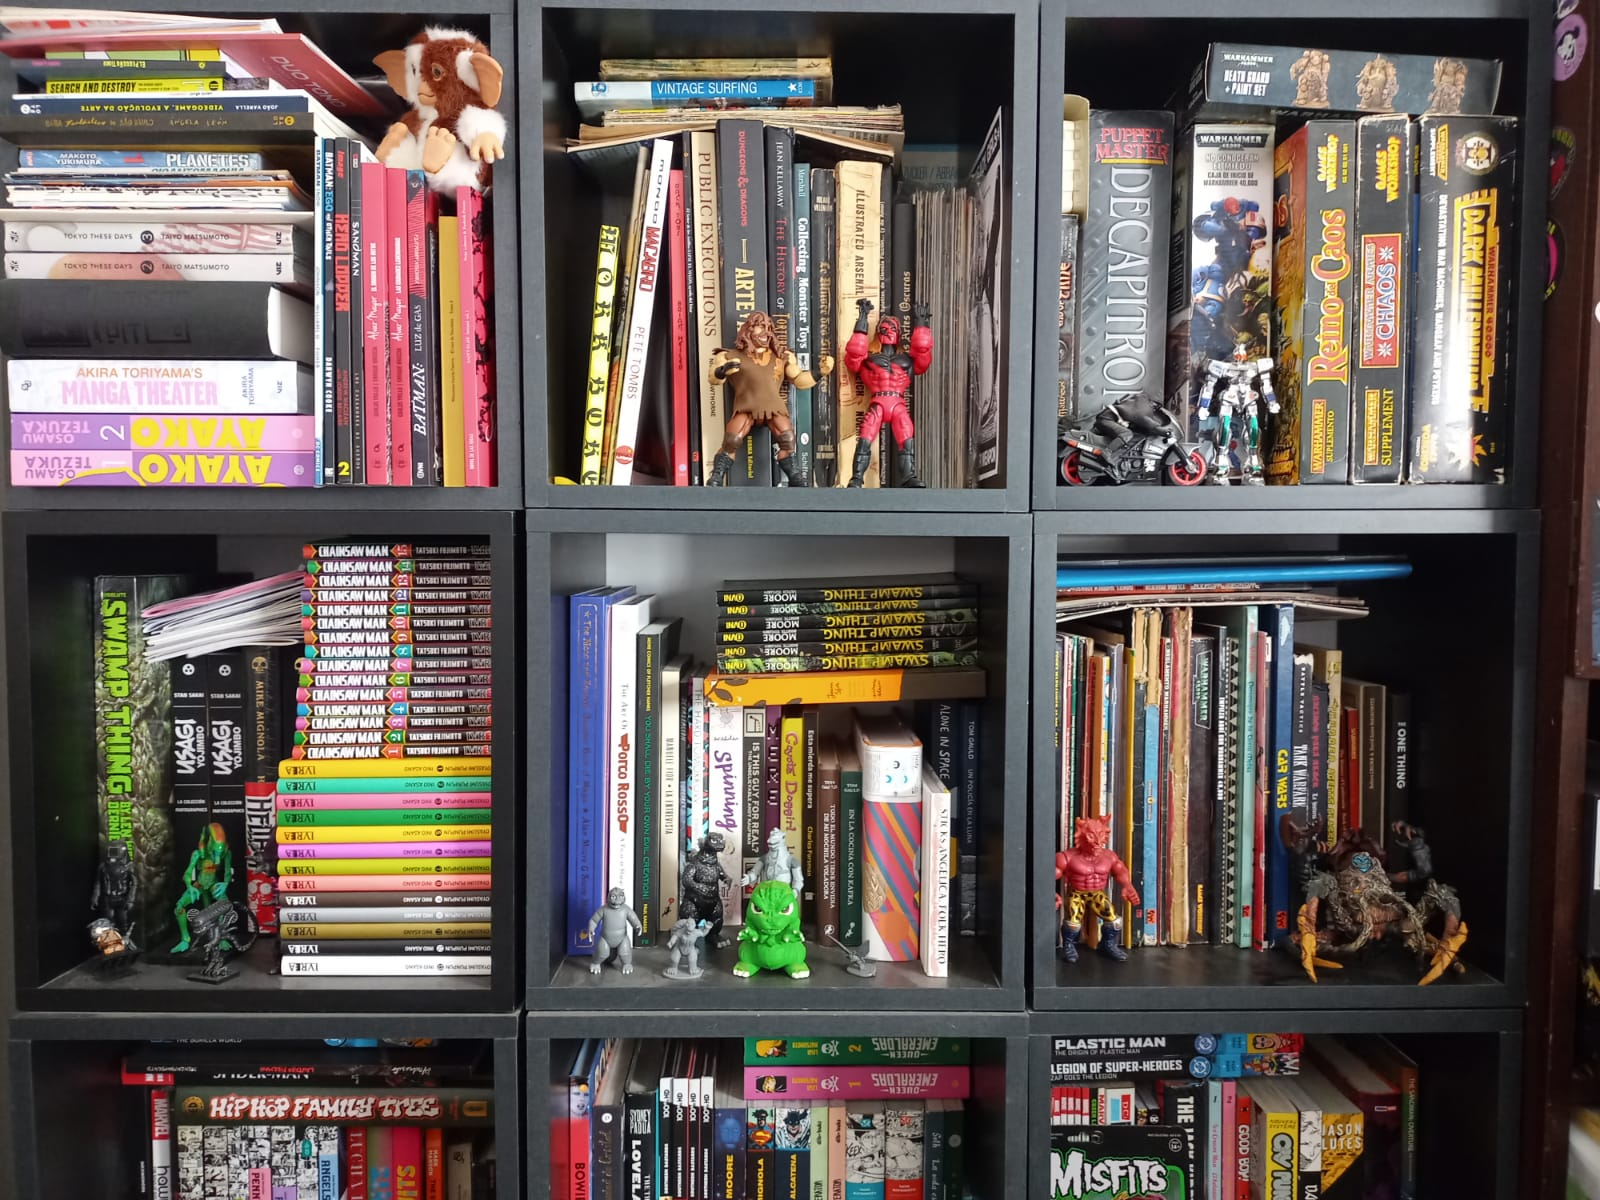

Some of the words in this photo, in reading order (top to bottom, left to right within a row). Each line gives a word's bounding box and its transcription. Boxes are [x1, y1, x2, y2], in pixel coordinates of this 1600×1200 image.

[50, 83, 80, 94] SEARCH
[83, 82, 99, 93] AND
[101, 81, 137, 92] DESTROY
[271, 55, 309, 81] DUO
[305, 82, 347, 108] TONO
[656, 83, 706, 95] VINTAGE
[708, 83, 758, 95] SURFING
[1223, 69, 1247, 83] DEATH
[1247, 71, 1271, 84] GUARD
[1231, 82, 1252, 95] PAINT
[1253, 84, 1266, 97] SET
[80, 104, 101, 112] ARTE
[103, 104, 115, 112] DA
[117, 103, 161, 113] EVOLUÇÃO
[262, 104, 278, 112] JOÃO
[1101, 128, 1167, 143] PUPPET
[1200, 135, 1262, 144] WARHAMMER
[165, 153, 250, 168] PLANETES
[738, 130, 747, 175] DUNGEONS
[776, 142, 784, 162] JEAN
[1095, 143, 1170, 165] MASTER
[1317, 146, 1328, 181] GAMES
[1326, 134, 1339, 193] WORKSHOP
[325, 152, 334, 190] BATMAN:
[737, 176, 749, 188] &
[798, 168, 806, 197] Marshall
[698, 152, 713, 217] PUBLIC
[776, 165, 785, 208] KELLAWAY
[325, 191, 334, 212] EGO
[739, 188, 748, 227] DRAGONS
[335, 214, 349, 252] HEAD
[776, 217, 788, 241] THE
[855, 190, 866, 251] ILLUSTRATED
[1436, 194, 1448, 248] DEVASTATING
[184, 233, 230, 241] MATSUMOTO
[795, 217, 809, 273] Collecting
[1311, 209, 1351, 281] Caos
[1461, 207, 1486, 263] DARK
[352, 222, 362, 276] SANDMAN
[639, 226, 661, 293] MACABRO
[1436, 248, 1446, 267] WAR
[335, 255, 349, 311] LOPPER
[700, 223, 717, 337] EXECUTIONS
[776, 246, 789, 294] HISTORY
[855, 255, 866, 295] ARSENAL
[735, 267, 755, 311] ARTE
[798, 277, 809, 323] Monster
[1325, 282, 1337, 297] del
[1376, 263, 1396, 340] CHAOS
[1433, 268, 1446, 310] MACHINES,
[413, 304, 422, 322] GAS
[776, 296, 784, 309] OF
[414, 323, 422, 332] de
[632, 326, 646, 353] PETE
[798, 326, 810, 349] Toys
[1433, 311, 1444, 350] WARGEAR
[414, 333, 422, 352] LUZ
[1307, 296, 1350, 386] Reino
[325, 357, 333, 388] DARWYN
[1433, 351, 1442, 368] AND
[76, 367, 118, 379] AKIRA
[122, 367, 203, 379] TORIYAMA'S
[626, 358, 641, 400] TOMBS
[62, 381, 131, 405] MANGA
[137, 381, 219, 405] THEATER
[412, 362, 427, 437] BATMAN:
[1431, 369, 1442, 405] PSYKERS
[325, 389, 333, 413] COOKE
[21, 421, 90, 433] TEZUKA
[22, 433, 75, 443] OSAMU
[99, 424, 125, 441] 2
[130, 418, 266, 449] AYAKO
[1312, 401, 1325, 472] WARHAMMER
[1326, 410, 1335, 462] SUPLEMENTO
[1381, 389, 1394, 466] SUPPLEMENT
[338, 461, 351, 476] 2
[319, 575, 366, 587] CHAINSAW
[367, 575, 389, 587] MAN
[398, 575, 408, 586] 13
[762, 632, 797, 641] MOORE
[822, 628, 866, 640] THING
[869, 626, 923, 637] SWAMP
[100, 599, 129, 698] SWAMP
[256, 680, 264, 707] MIKE
[1199, 657, 1209, 721] WARHAMMER
[939, 704, 951, 734] ALONE
[174, 718, 197, 775] USAGI
[196, 725, 206, 769] YOJIMBO
[256, 709, 265, 761] MIGNOLA
[752, 742, 760, 752] IS
[807, 729, 815, 746] Esta
[939, 736, 950, 747] IN
[1397, 728, 1407, 753] ONE
[104, 705, 133, 795] THING
[783, 731, 798, 777] Coyote
[807, 746, 815, 771] mierda
[1277, 748, 1288, 773] CAR
[1294, 744, 1308, 767] TANK
[752, 753, 760, 776] THIS
[807, 771, 813, 783] me
[939, 750, 951, 779] SPACE
[1396, 754, 1406, 789] THING
[714, 750, 739, 833] Spinning
[752, 777, 760, 798] GUY
[806, 783, 814, 809] supera
[1277, 776, 1288, 809] WARS
[1292, 769, 1307, 808] WARFARE
[752, 800, 760, 820] FOR
[784, 780, 798, 832] Doggirl
[847, 809, 855, 820] EN
[752, 821, 760, 853] REAL?
[847, 821, 855, 831] LA
[847, 832, 855, 861] COCINA
[847, 862, 855, 879] CON
[847, 880, 855, 906] KAFKA
[288, 945, 319, 953] IVREA
[1055, 1037, 1132, 1049] PLASTIC
[1135, 1036, 1166, 1048] MAN
[1050, 1063, 1088, 1074] LEGION
[1090, 1062, 1103, 1073] OF
[1105, 1060, 1183, 1072] SUPER-HEROES
[871, 1073, 938, 1088] EMERALDAS
[889, 1087, 920, 1095] QUEEN
[154, 1098, 169, 1137] MARVEL
[1321, 1123, 1364, 1137] JASON
[1238, 1124, 1250, 1154] GOOD
[1322, 1137, 1362, 1150] LUTES
[1050, 1150, 1168, 1199] MISFITS
[1238, 1156, 1250, 1182] BOY!
